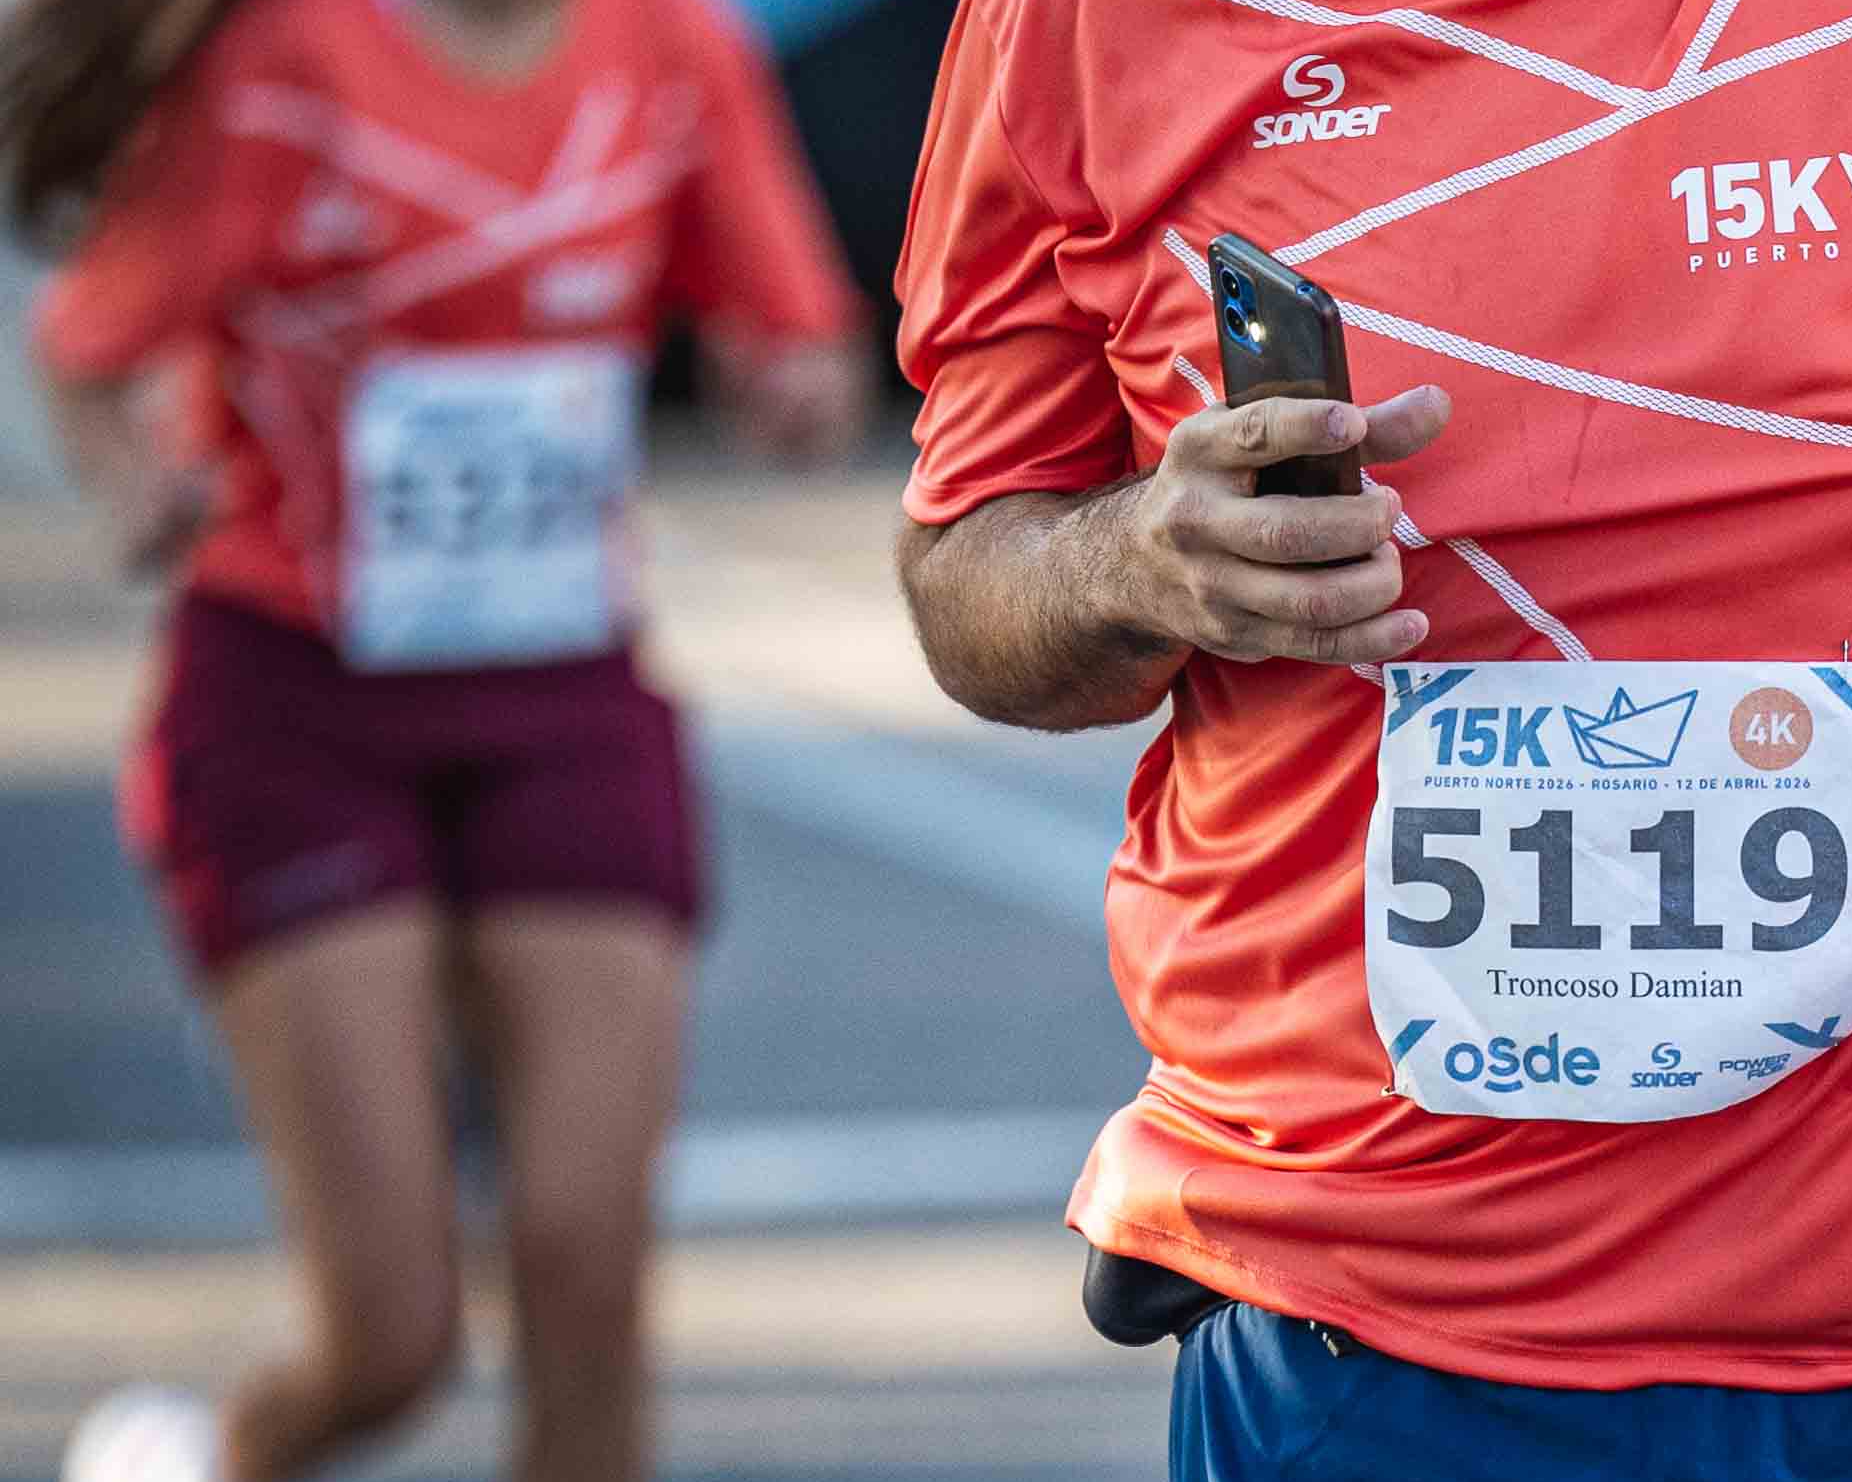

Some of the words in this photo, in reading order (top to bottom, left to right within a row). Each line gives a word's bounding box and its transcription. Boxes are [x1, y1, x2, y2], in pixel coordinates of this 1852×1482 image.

[1669, 155, 1839, 245] 15K
[1689, 241, 1840, 273] PUERTO
[1429, 705, 1553, 768] 15K
[1744, 712, 1800, 746] 4K
[1423, 775, 1480, 788] PUERTO
[1484, 776, 1532, 789] NORTE
[1537, 778, 1574, 790] 2026
[1591, 778, 1658, 791] ROSARIO
[1676, 779, 1694, 790] 12
[1699, 778, 1717, 790] DE
[1723, 777, 1769, 790] ABRIL
[1774, 776, 1811, 789] 2026
[1386, 805, 1850, 952] 5119
[1486, 968, 1619, 999] Troncoso
[1629, 969, 1744, 999] Damian
[1444, 1031, 1601, 1087] osde
